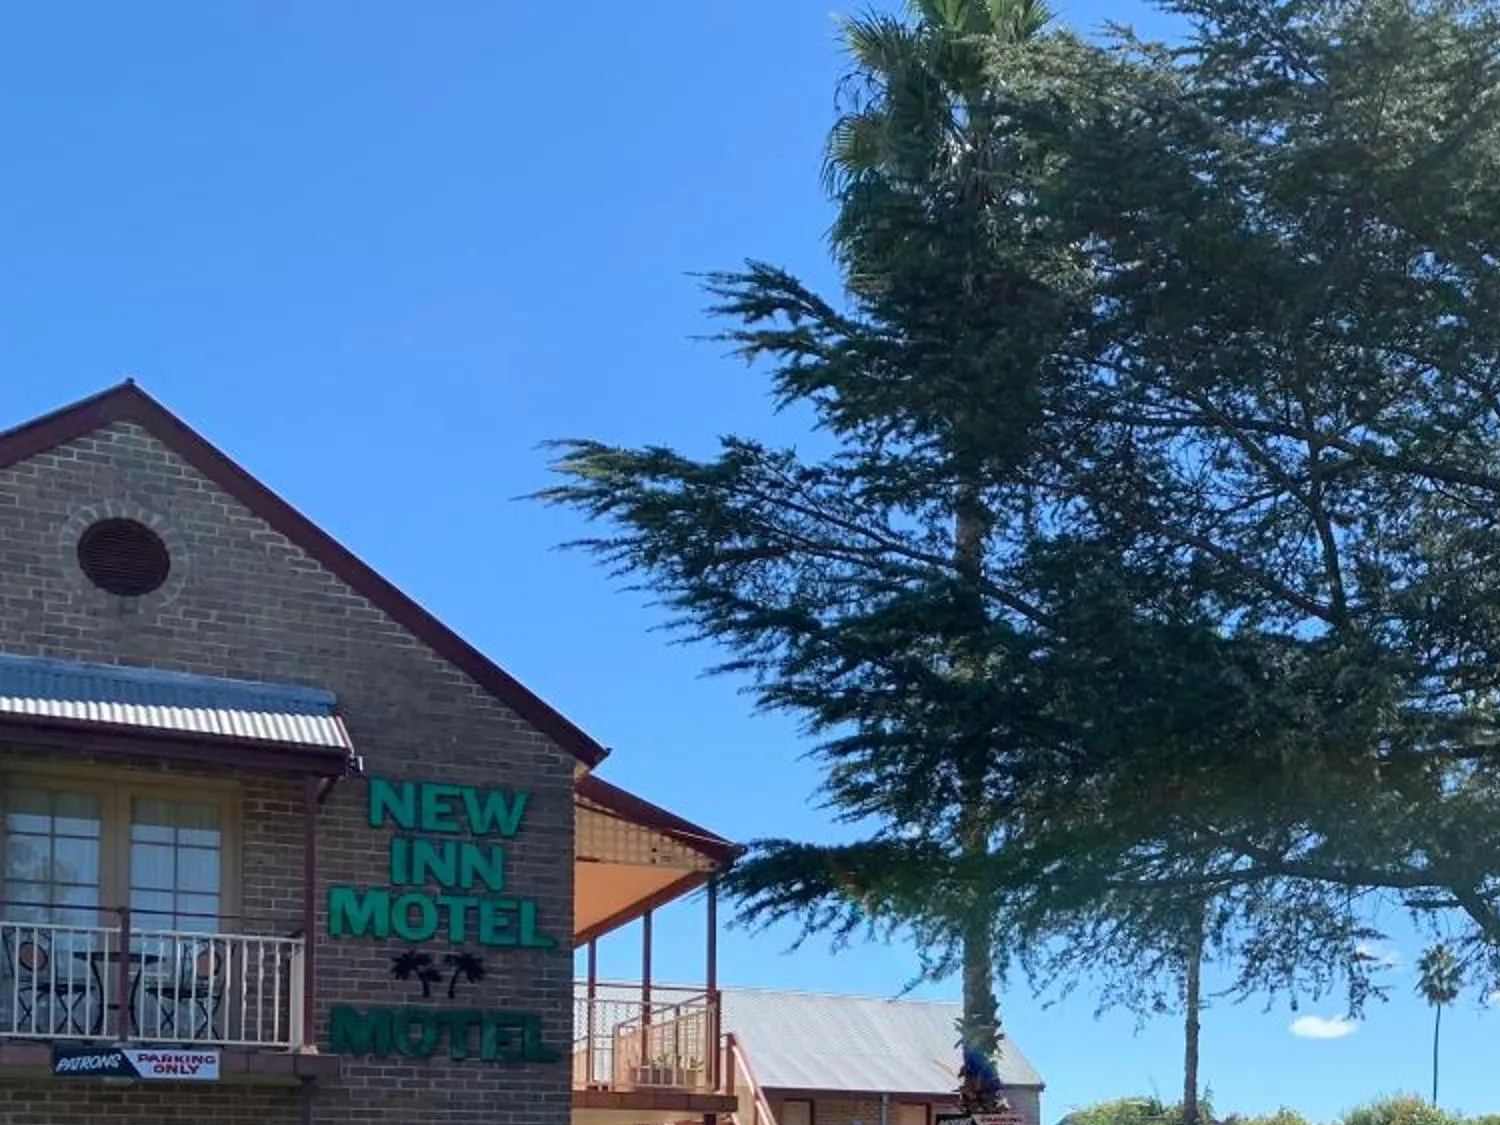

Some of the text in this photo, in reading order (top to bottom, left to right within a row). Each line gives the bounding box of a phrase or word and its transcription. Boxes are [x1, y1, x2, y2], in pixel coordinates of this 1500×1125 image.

[367, 775, 531, 837] NEW
[389, 834, 508, 893] INN
[327, 884, 559, 950] MOTEL
[55, 1053, 122, 1072] PATRONS
[137, 1053, 217, 1064] PARKING
[328, 1004, 561, 1064] MOTEL
[153, 1064, 200, 1075] ONLY
